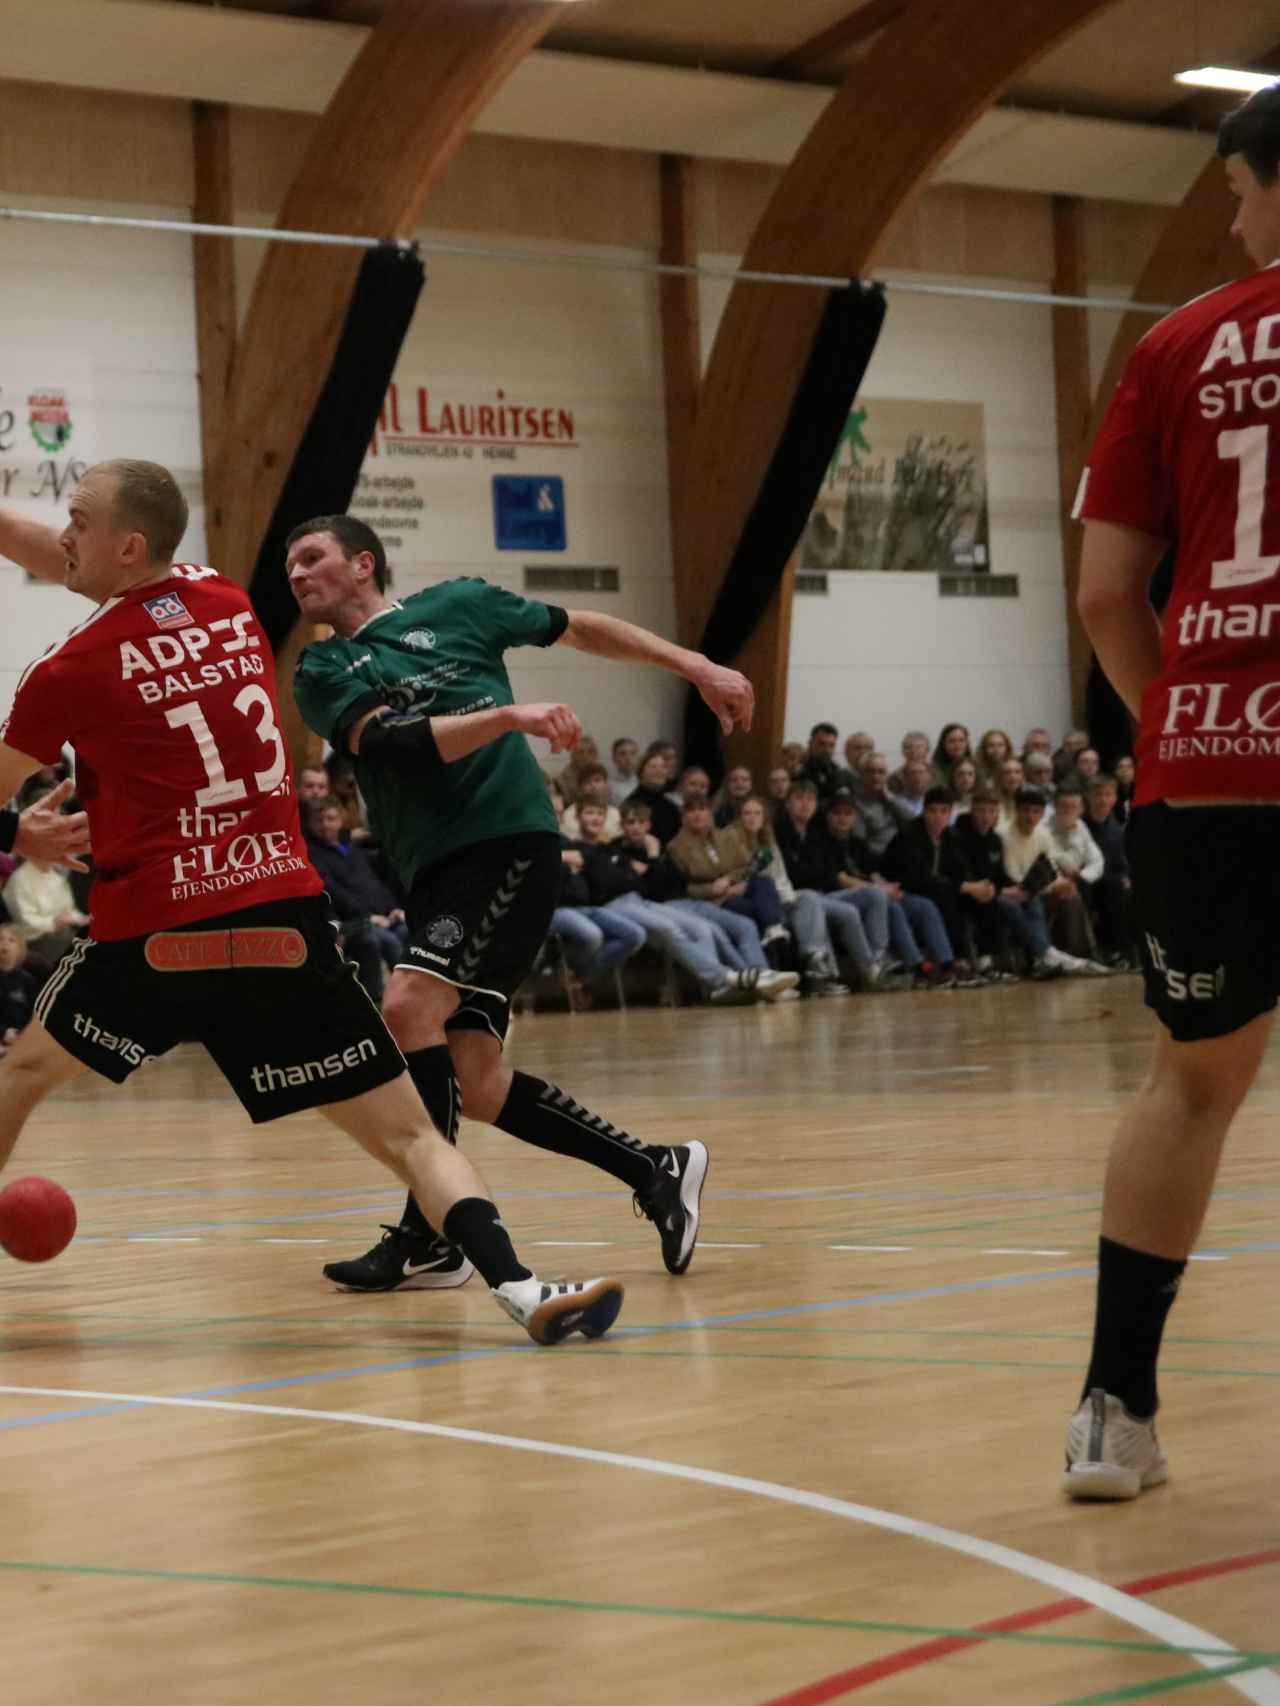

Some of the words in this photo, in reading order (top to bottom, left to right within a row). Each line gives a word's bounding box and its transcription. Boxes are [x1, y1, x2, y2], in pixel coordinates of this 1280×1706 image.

[136, 653, 266, 704] BALSTAD
[163, 683, 287, 808] 13
[250, 1038, 377, 1093] thansen
